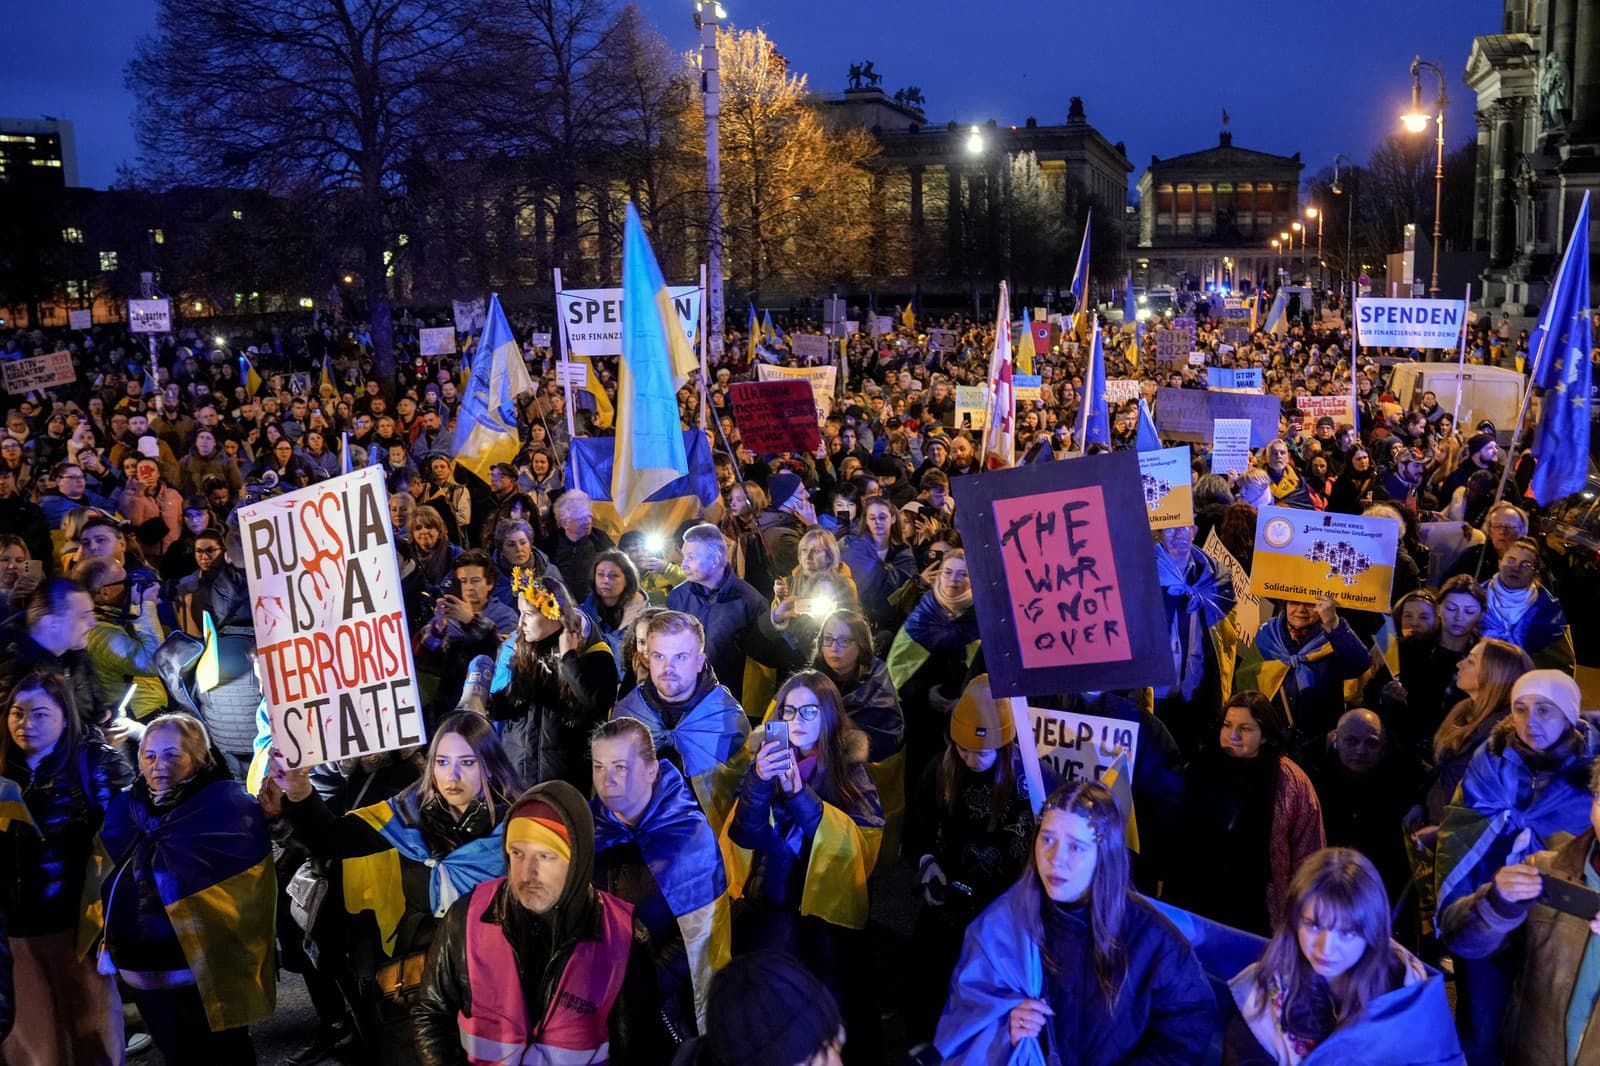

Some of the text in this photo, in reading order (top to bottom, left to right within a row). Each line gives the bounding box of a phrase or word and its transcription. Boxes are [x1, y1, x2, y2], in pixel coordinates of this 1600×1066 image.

[569, 299, 691, 324] SPEN
[1360, 306, 1457, 325] SPENDEN
[572, 332, 623, 341] ZUR FINANZI
[1158, 345, 1188, 355] 2022
[1374, 329, 1422, 337] FINANZIERUNG
[1237, 380, 1255, 388] WAR
[248, 483, 389, 580] RUSSIA
[1000, 500, 1090, 564] THE
[1303, 525, 1310, 534] 3
[1024, 557, 1102, 593] WAR
[286, 557, 376, 634] IS A
[1056, 585, 1114, 622] NOT
[1263, 582, 1376, 604] Solidarität mit der Ukraine!
[1034, 620, 1120, 656] OVER
[258, 611, 409, 705] TERRORIST
[283, 679, 420, 769] STATE
[1032, 716, 1093, 751] HELP
